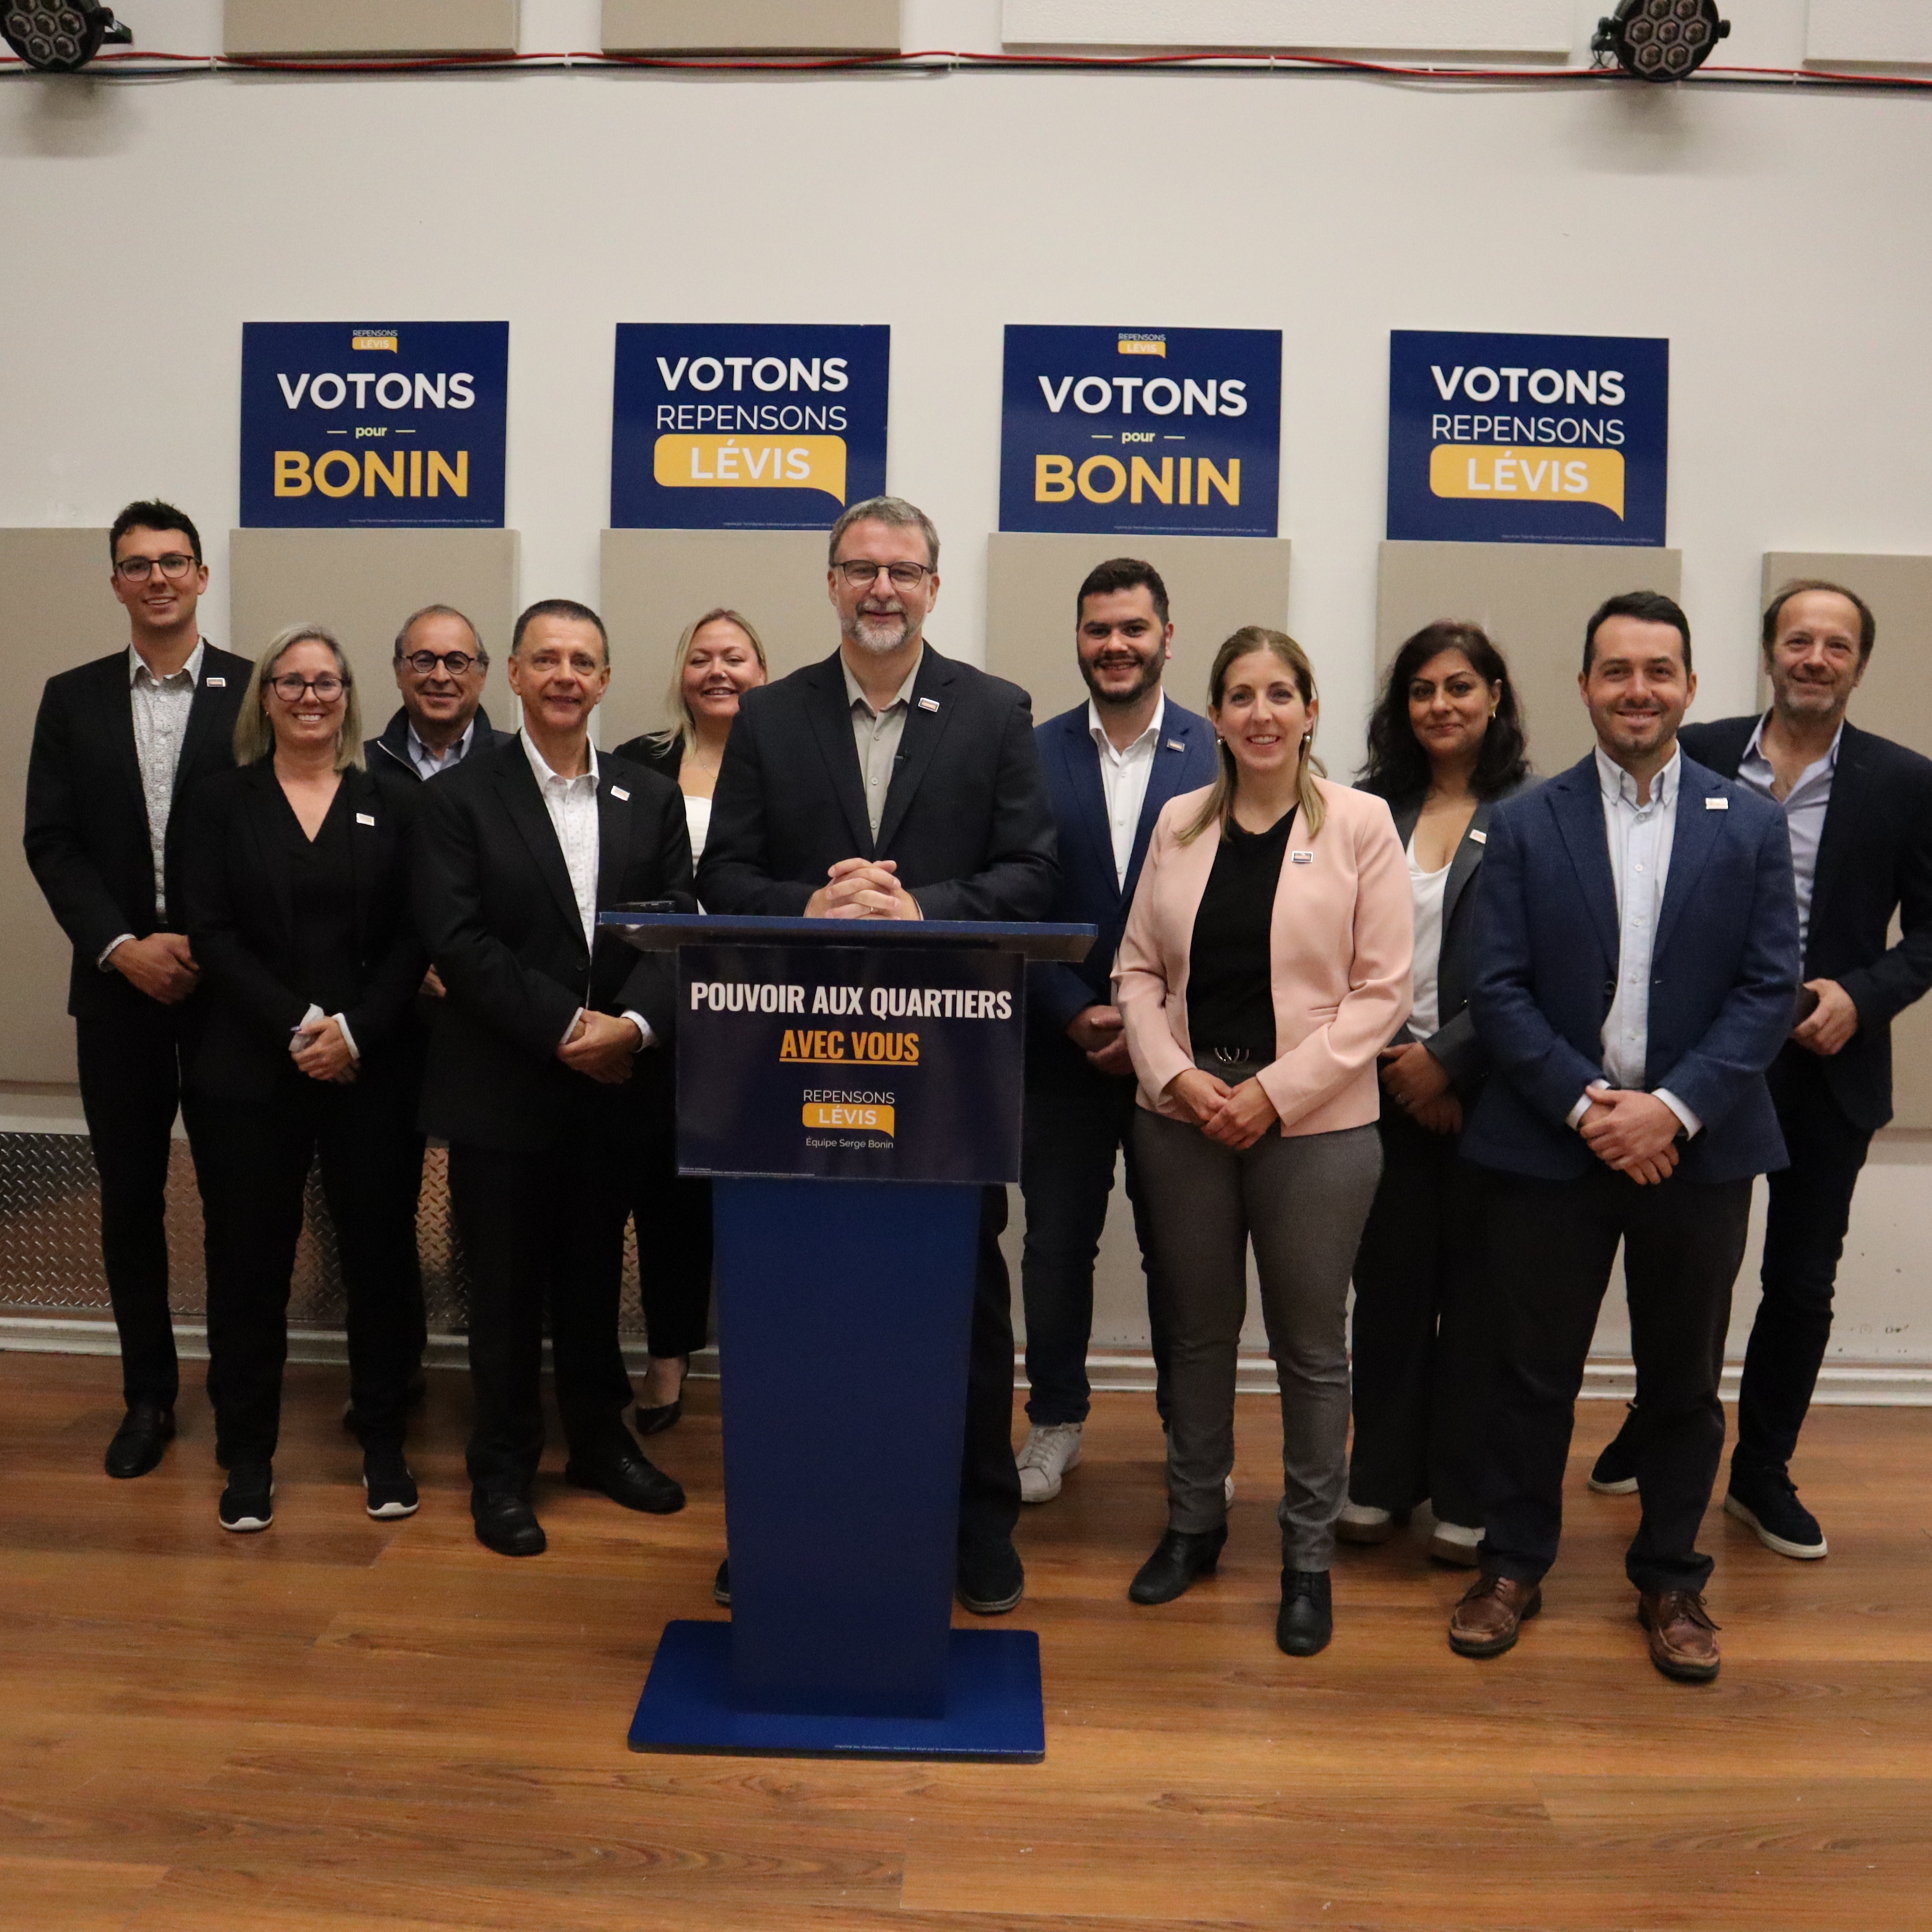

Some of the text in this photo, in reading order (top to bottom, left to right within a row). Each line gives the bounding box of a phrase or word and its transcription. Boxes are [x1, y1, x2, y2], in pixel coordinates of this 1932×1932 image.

[360, 338, 389, 348] LÉVIS
[1127, 342, 1157, 353] LÉVIS
[656, 356, 848, 392] VOTONS
[1431, 365, 1626, 406] VOTONS
[277, 372, 475, 410] VOTONS
[1038, 376, 1248, 417] VOTONS
[355, 427, 387, 439] pour
[657, 405, 847, 431] REPENSONS
[1432, 414, 1625, 445] REPENSONS
[1122, 431, 1155, 443] pour
[274, 450, 469, 497] BONIN
[691, 439, 810, 480] LÉVIS
[1467, 451, 1589, 494] LÉVIS
[1035, 454, 1240, 506] BONIN
[691, 981, 1012, 1021] POUVOIR AUX QUARTIERS
[780, 1029, 919, 1062] AVEC VOUS
[803, 1090, 895, 1104] REPENSONS
[819, 1105, 877, 1125] LÉVIS
[806, 1136, 894, 1150] Équipe Serge Bonin
